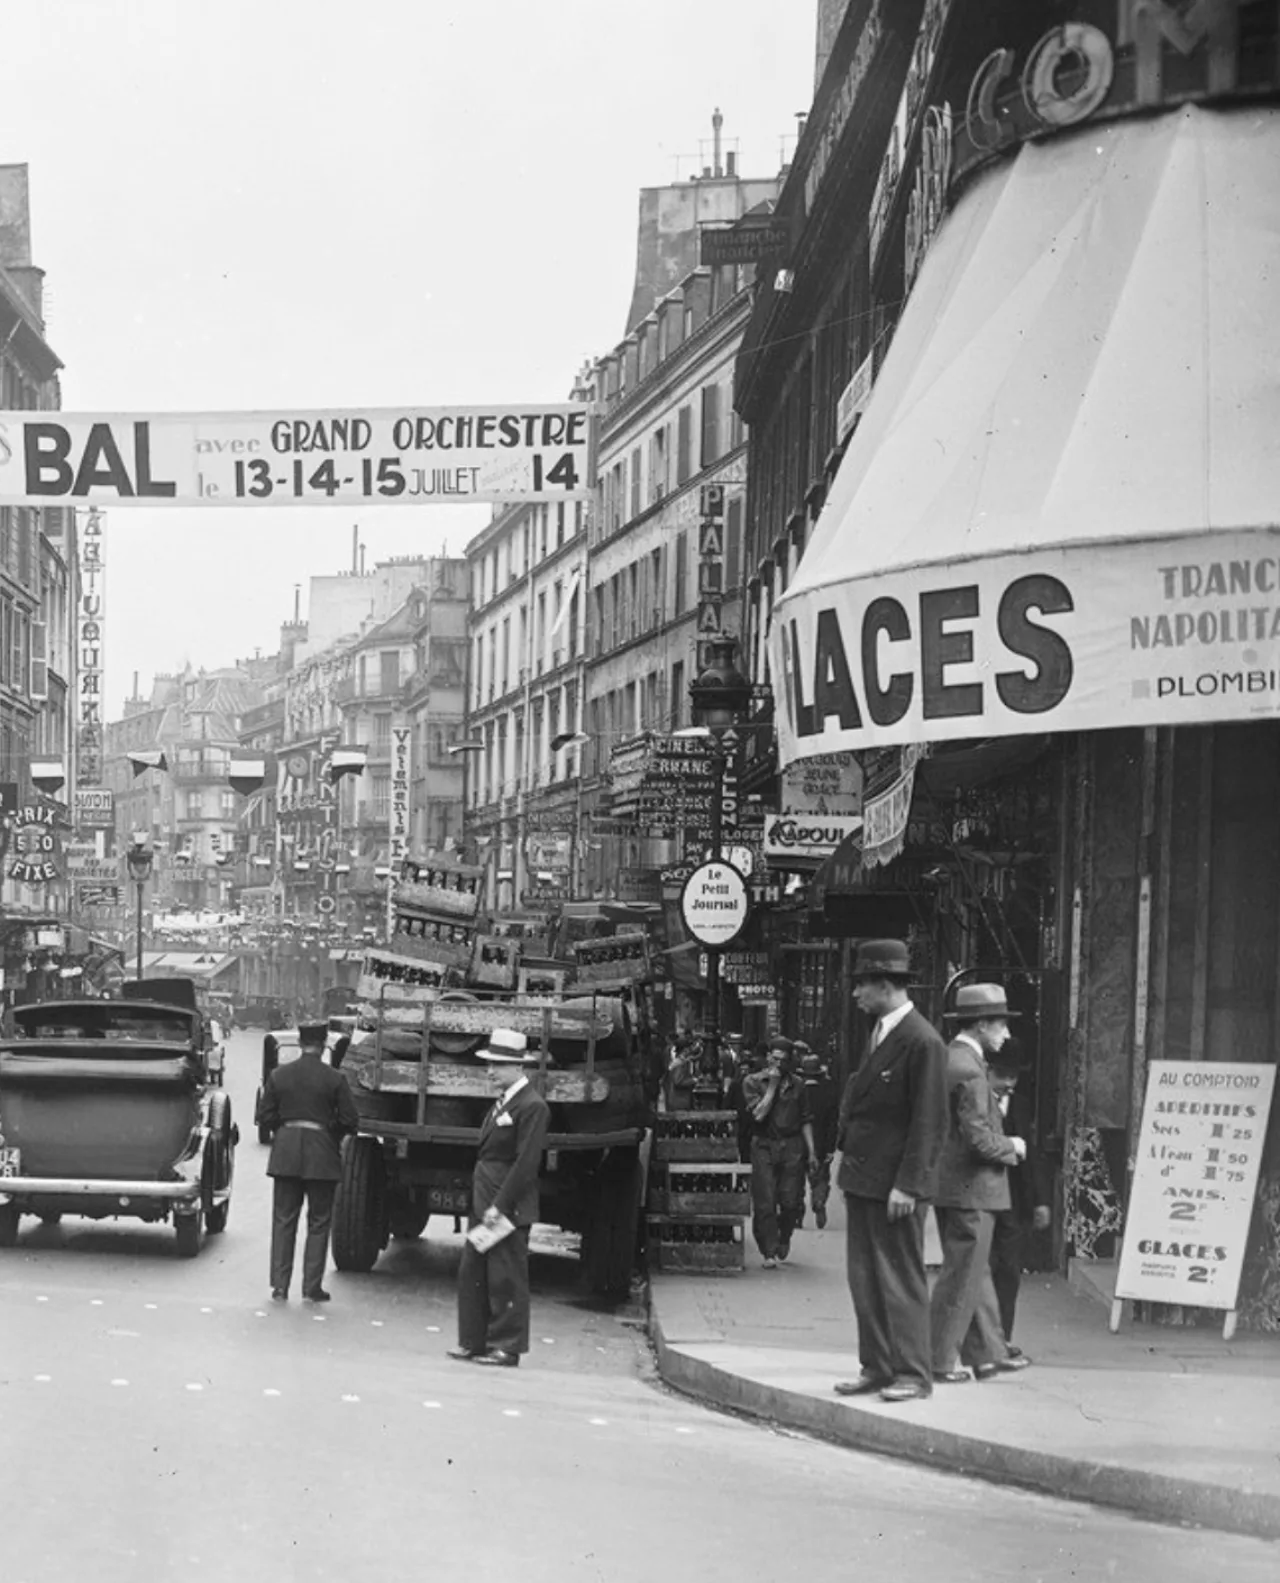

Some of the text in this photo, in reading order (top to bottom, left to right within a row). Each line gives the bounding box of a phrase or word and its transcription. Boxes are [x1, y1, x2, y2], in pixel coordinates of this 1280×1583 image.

[23, 421, 177, 497] BAL
[194, 436, 261, 455] avec
[271, 418, 372, 453] GRAND
[392, 411, 587, 451] ORCHESTRE
[197, 473, 219, 499] le
[408, 467, 481, 496] JUILLET
[532, 452, 580, 492] 14
[1157, 557, 1280, 601] TRANC
[1157, 669, 1280, 698] PLOMBI
[11, 861, 57, 881] FIXE
[707, 868, 723, 881] Le
[701, 883, 730, 895] Petit
[691, 898, 739, 912] Journal
[1158, 1072, 1261, 1089] AU COMPTOIR
[1232, 1128, 1253, 1140] 25
[1227, 1153, 1249, 1165] 50
[1226, 1170, 1246, 1183] 75
[1137, 1239, 1228, 1262] GLACES
